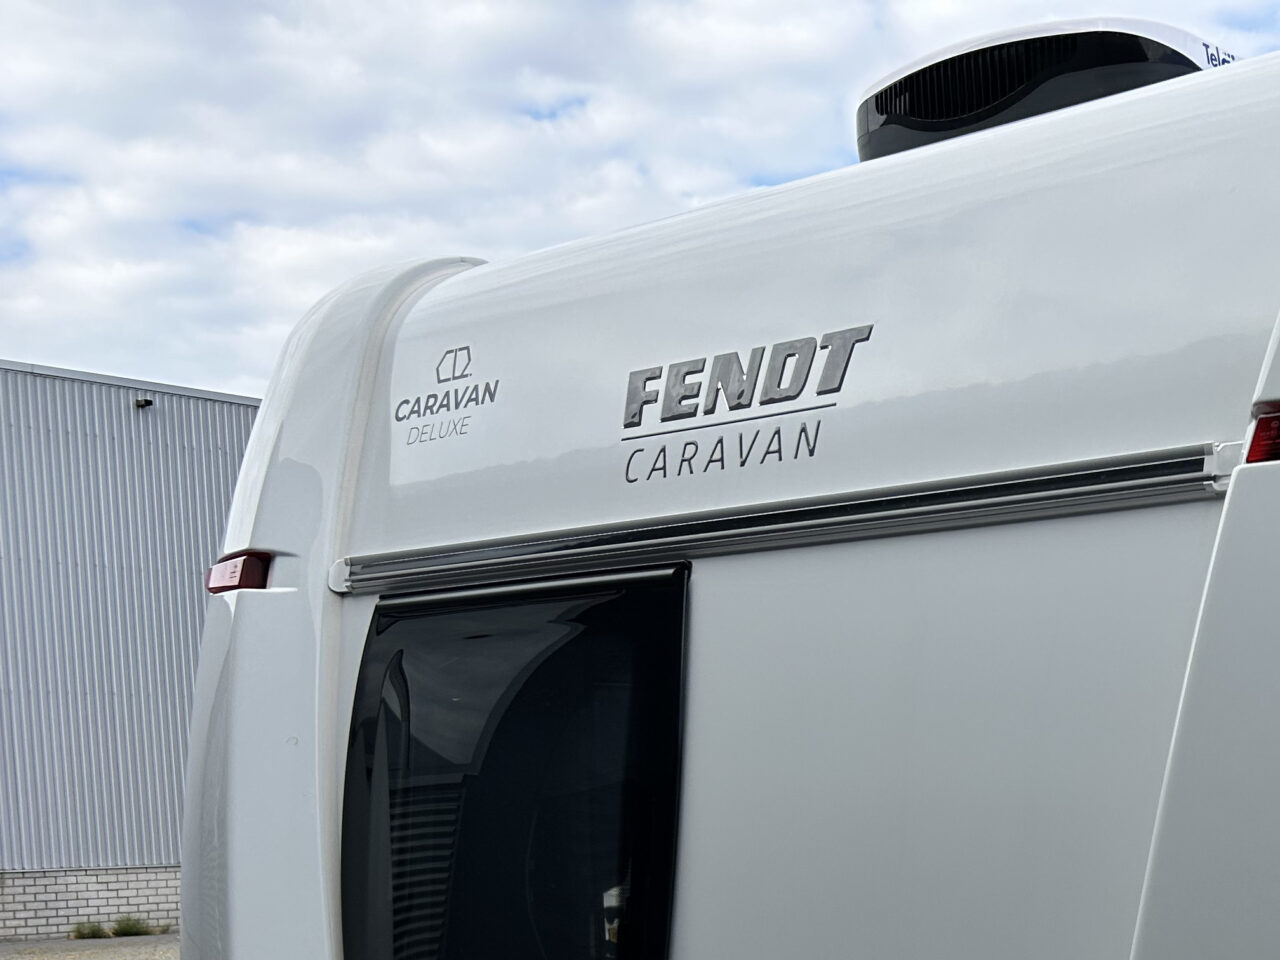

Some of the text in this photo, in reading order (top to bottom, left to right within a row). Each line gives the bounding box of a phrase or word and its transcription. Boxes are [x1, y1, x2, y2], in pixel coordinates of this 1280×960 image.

[395, 379, 499, 422] CARAVAN
[621, 323, 875, 429] FENDT
[407, 416, 472, 445] DELUXE
[625, 419, 822, 484] CARAVAN
